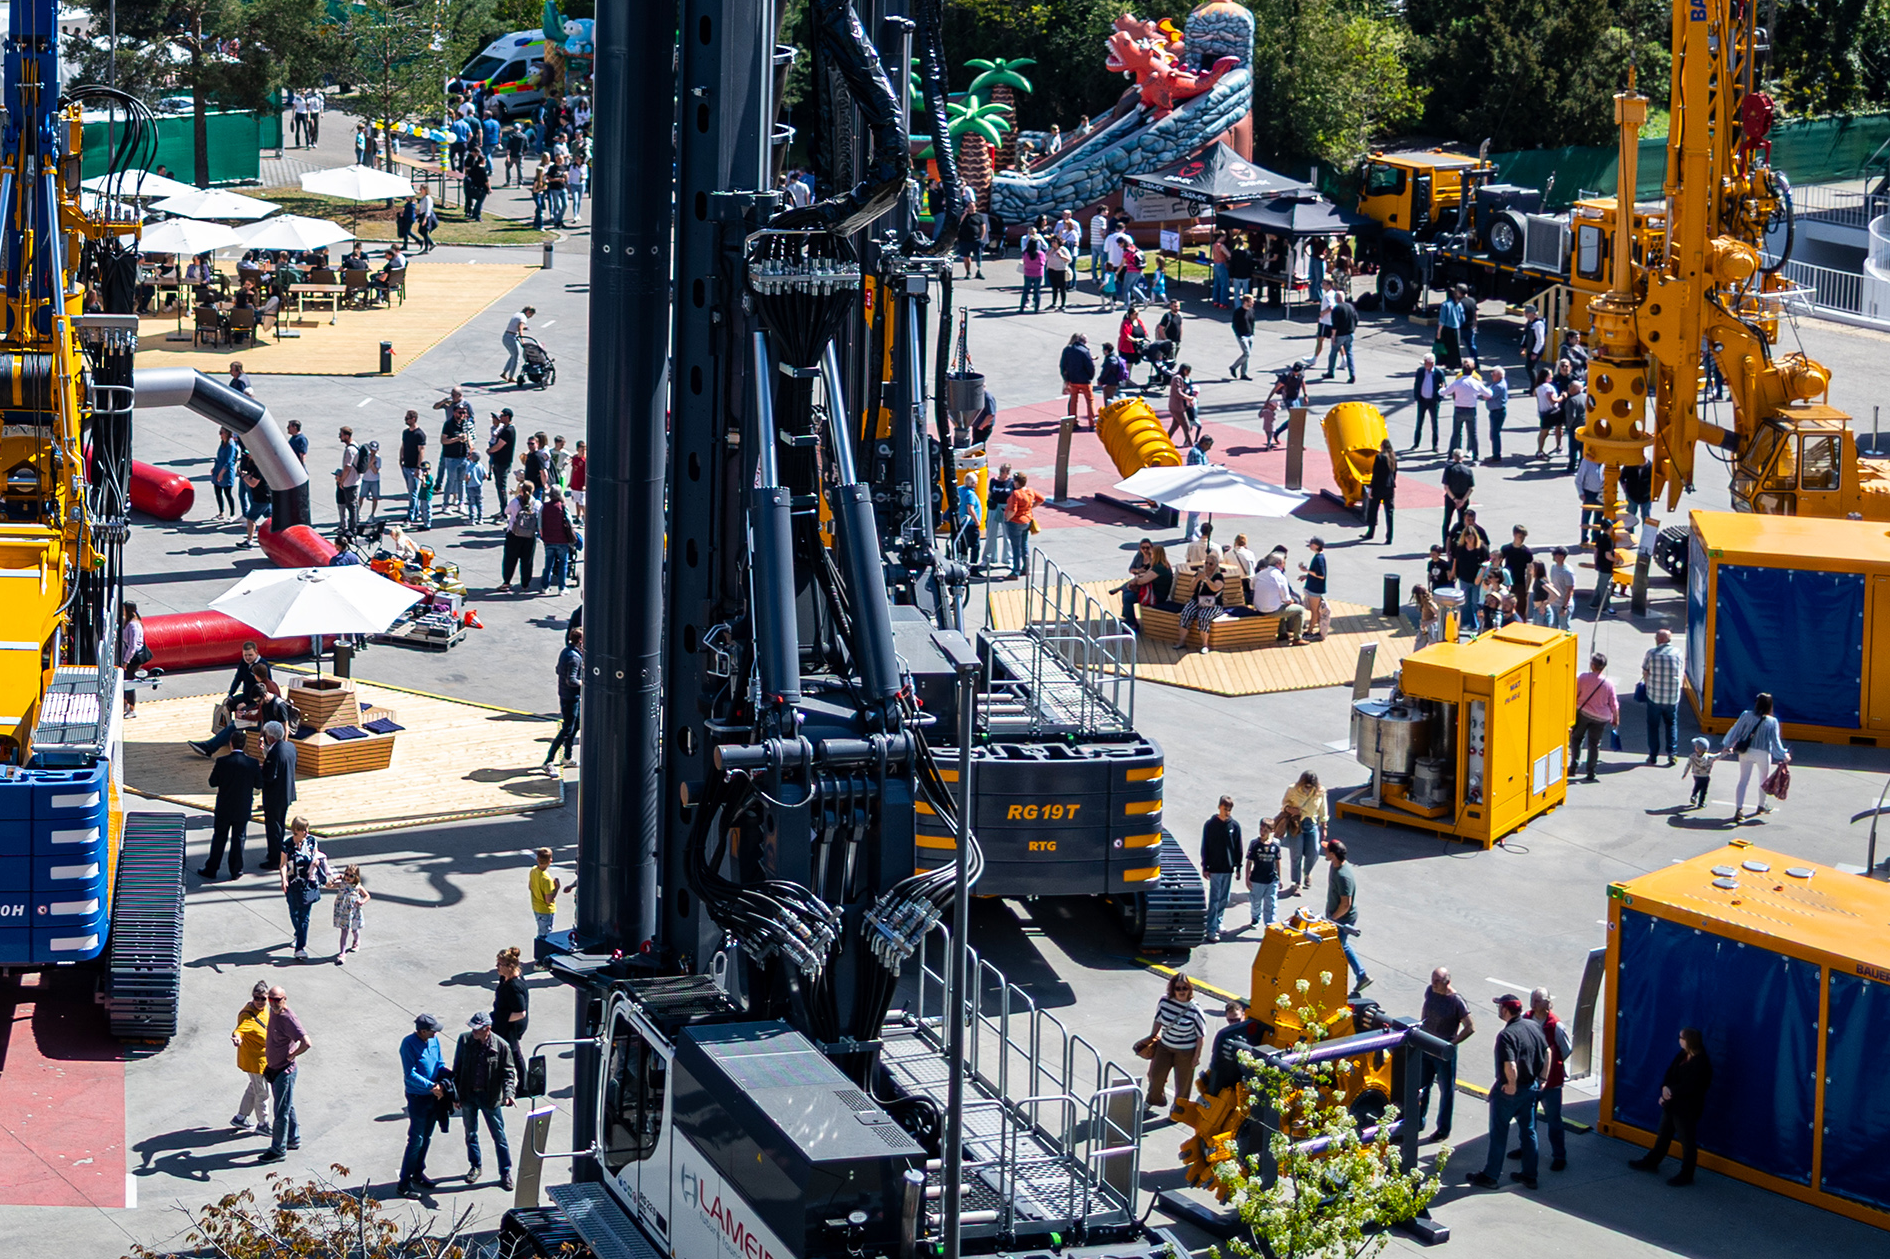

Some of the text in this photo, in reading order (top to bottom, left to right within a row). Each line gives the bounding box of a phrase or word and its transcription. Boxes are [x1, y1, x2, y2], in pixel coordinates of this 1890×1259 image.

[1007, 804, 1081, 820] RG 19 T
[1028, 841, 1057, 851] RTG
[11, 905, 25, 916] H
